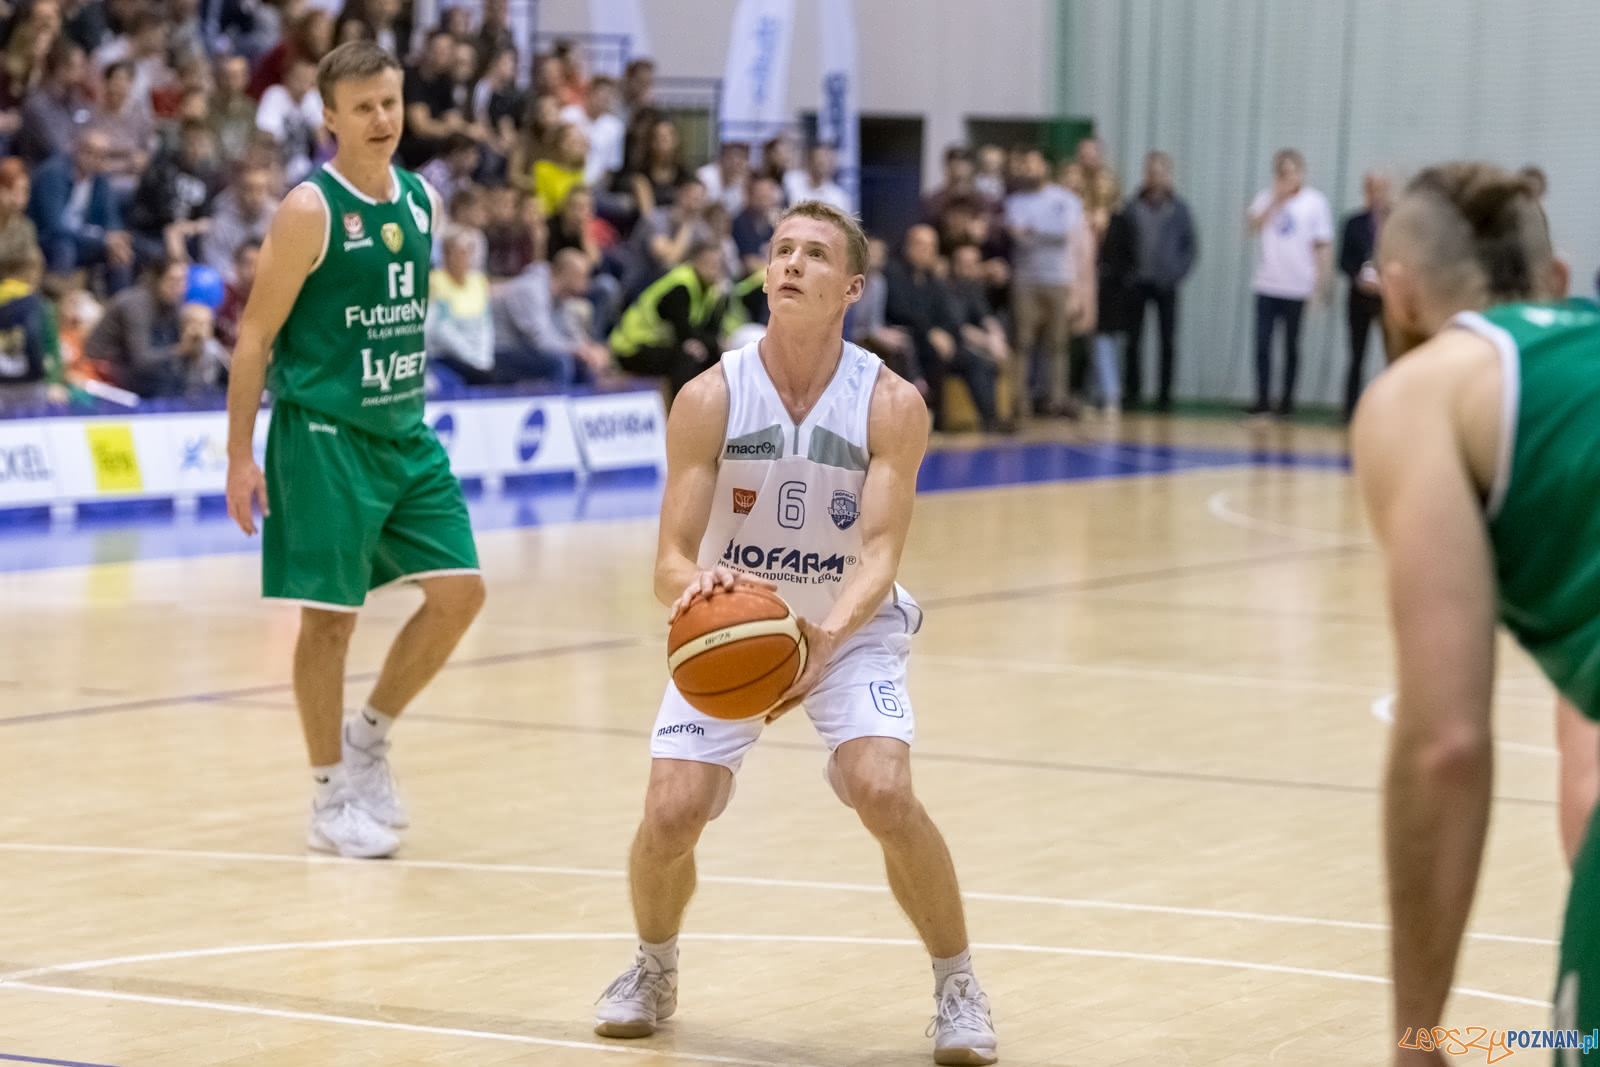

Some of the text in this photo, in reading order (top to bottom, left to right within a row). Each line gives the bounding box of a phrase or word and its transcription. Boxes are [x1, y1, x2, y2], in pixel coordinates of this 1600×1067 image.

[726, 441, 776, 455] macron
[777, 480, 807, 530] 6
[869, 680, 905, 719] 6
[656, 722, 706, 737] macron
